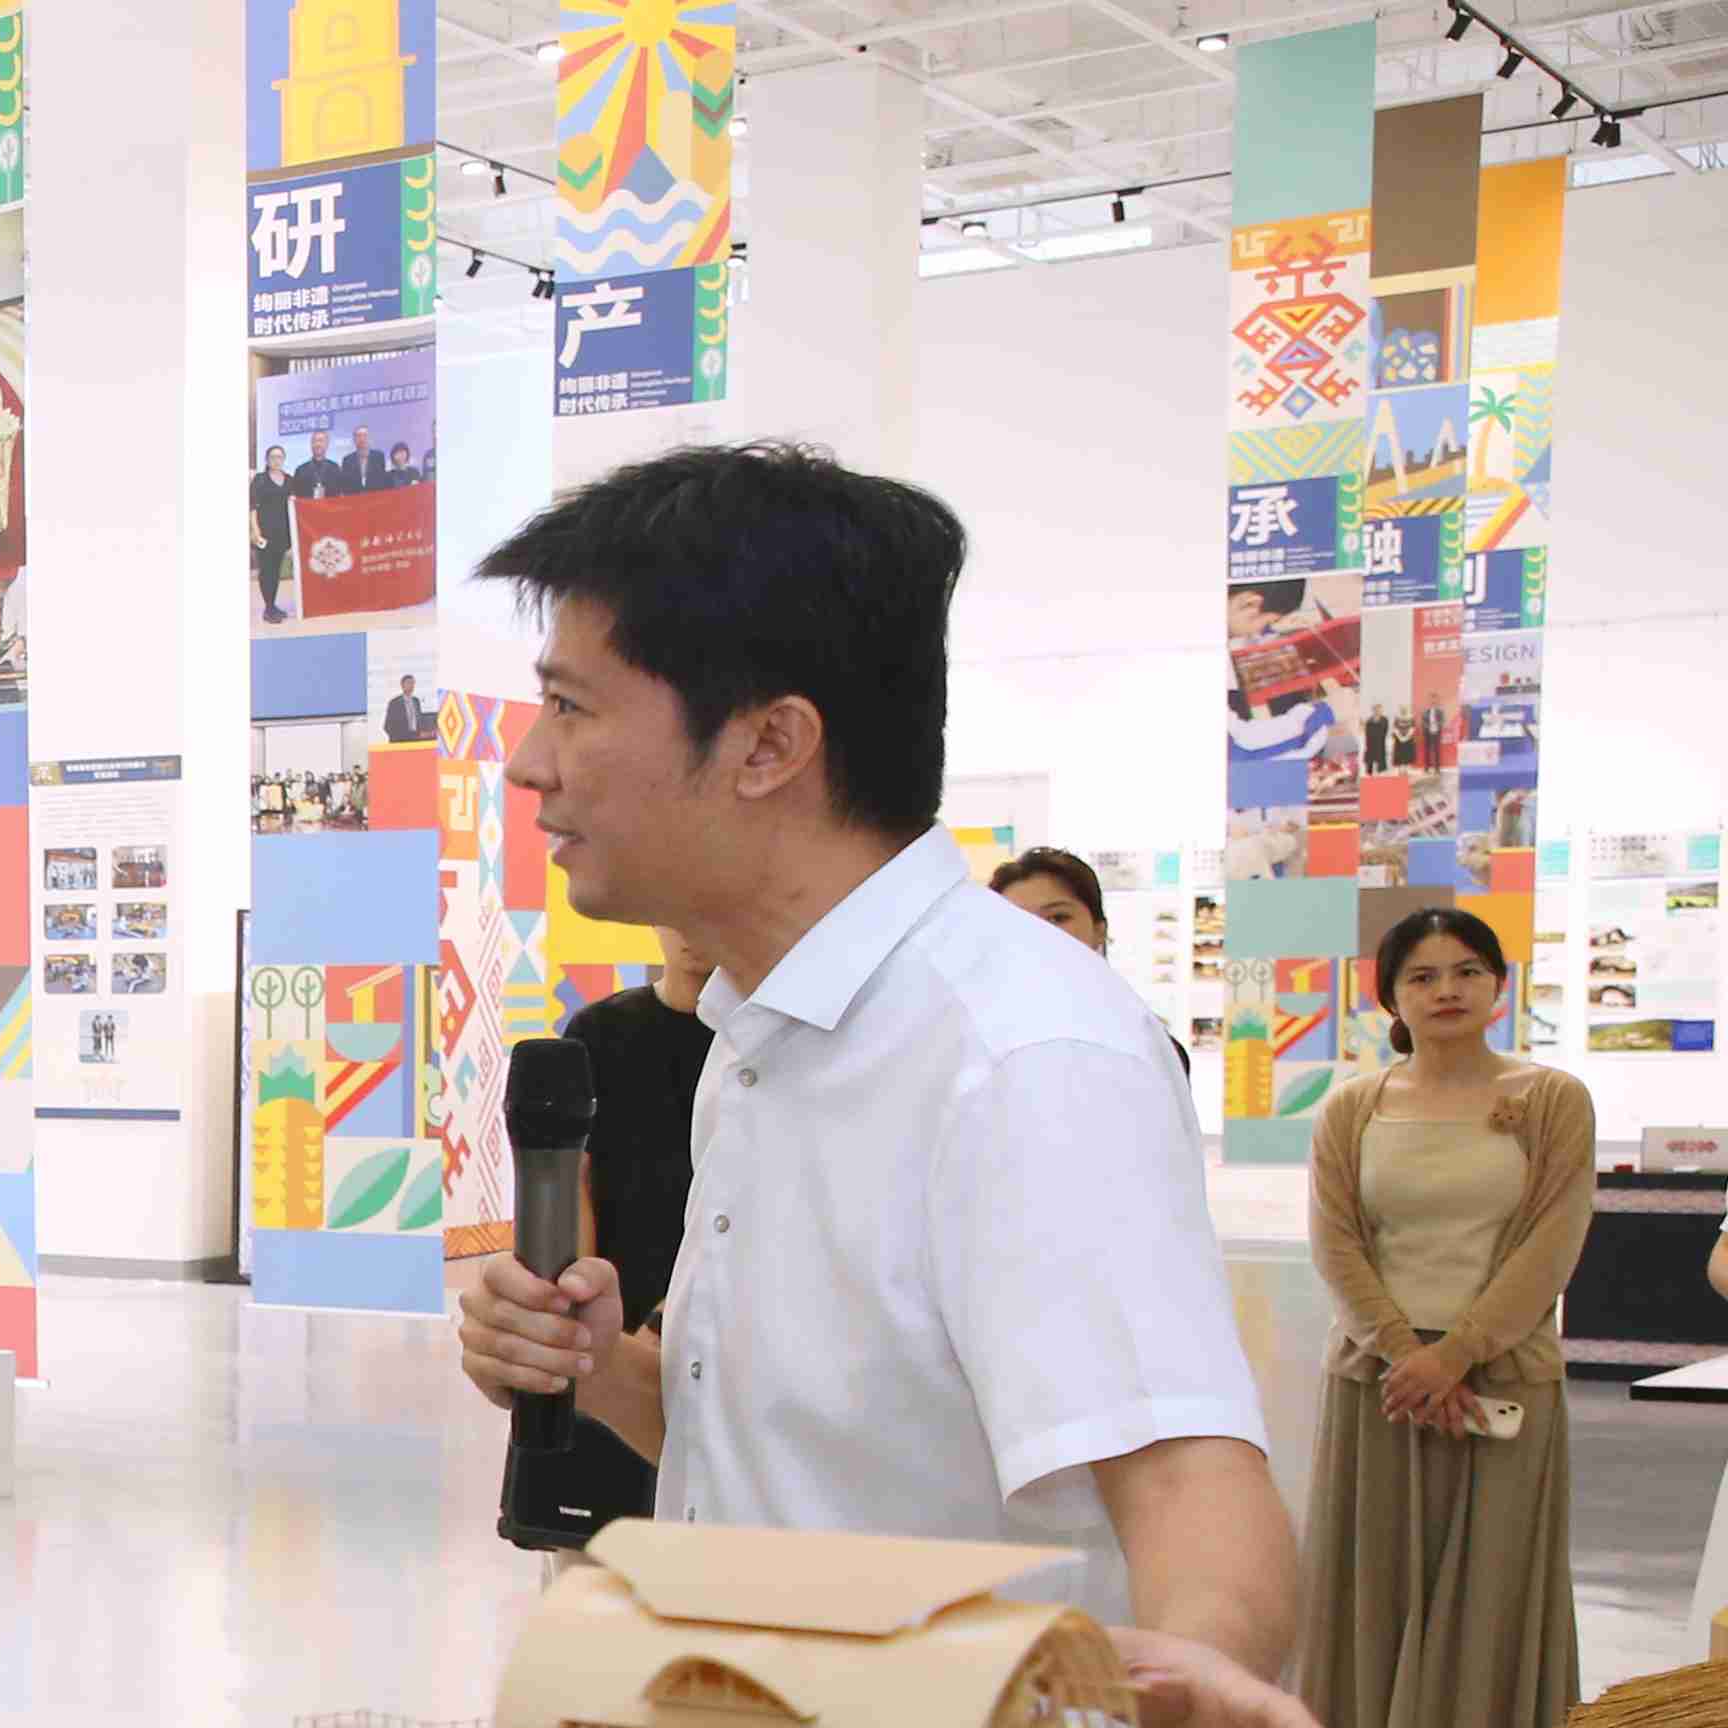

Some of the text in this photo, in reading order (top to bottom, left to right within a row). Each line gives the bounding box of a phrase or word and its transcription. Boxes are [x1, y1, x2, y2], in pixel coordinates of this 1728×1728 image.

[251, 182, 346, 279] 研
[558, 281, 644, 369] 产
[1229, 486, 1299, 546] 承
[1464, 643, 1536, 664] ESIGN
